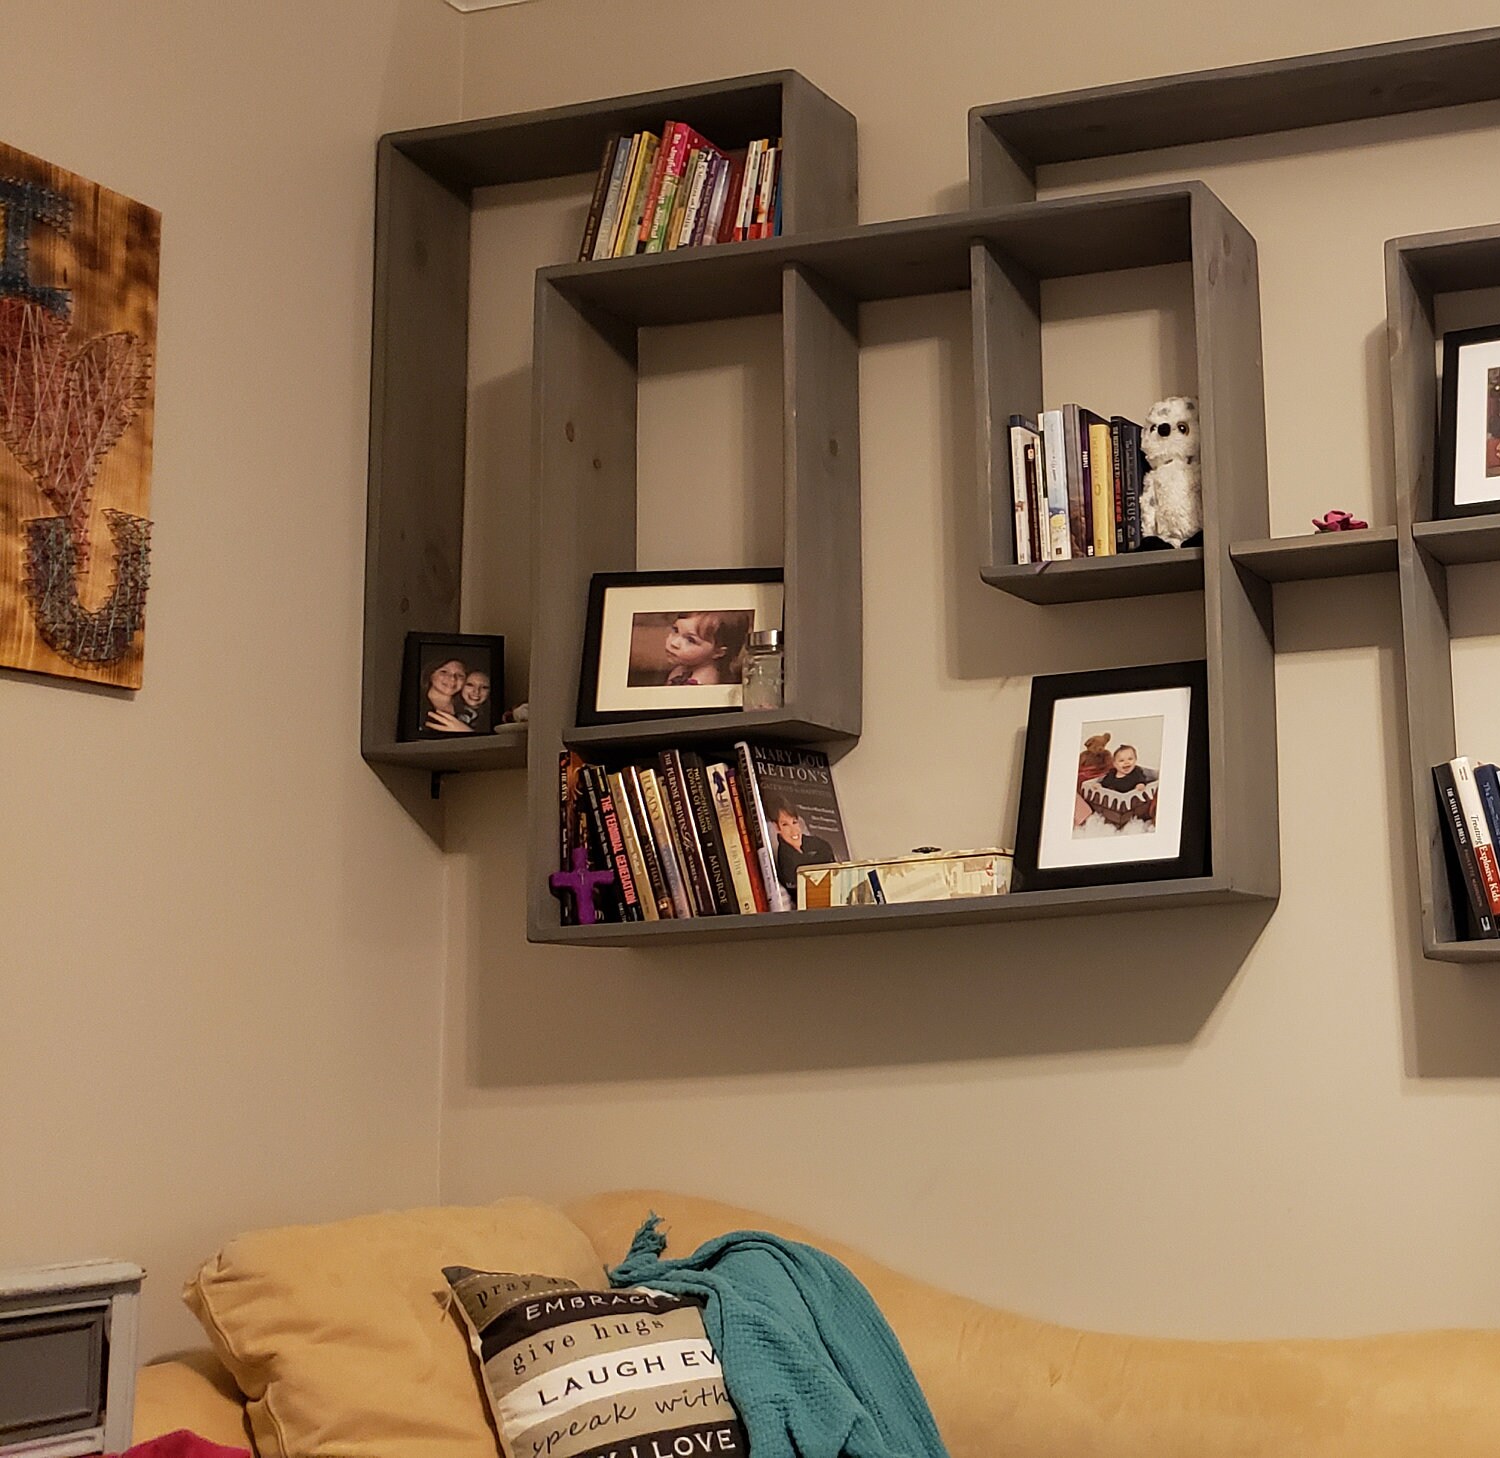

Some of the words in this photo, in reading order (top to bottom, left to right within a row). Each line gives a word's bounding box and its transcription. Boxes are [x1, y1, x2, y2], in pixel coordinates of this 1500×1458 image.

[664, 145, 678, 174] Joyful
[650, 206, 663, 239] Journal
[1126, 492, 1137, 521] JESUS
[662, 753, 672, 765] THE
[754, 746, 792, 763] MARY
[798, 752, 824, 769] LOU
[665, 766, 680, 798] PURPOSE
[685, 768, 698, 793] POWER
[692, 768, 700, 780] THE
[756, 761, 828, 784] RETTON'S
[599, 795, 613, 812] THE
[640, 773, 662, 822] LUCADO
[692, 793, 701, 806] OF
[1482, 782, 1492, 796] The
[673, 801, 687, 829] DRIVEN
[695, 806, 708, 834] VISION
[1447, 797, 1459, 814] SEVEN
[603, 813, 624, 854] TERMINAL
[1468, 814, 1485, 845] Treating
[1475, 845, 1496, 882] Explosive
[614, 853, 637, 904] GENERATION
[708, 854, 728, 905] MUNROE
[1487, 882, 1500, 902] Kids
[475, 1280, 532, 1309] pray
[512, 1336, 576, 1375] give
[591, 1319, 665, 1340] hugs
[537, 1355, 666, 1406] LAUGH
[532, 1402, 638, 1457] speak
[655, 1384, 729, 1414] with
[651, 1428, 736, 1458] LOVE
